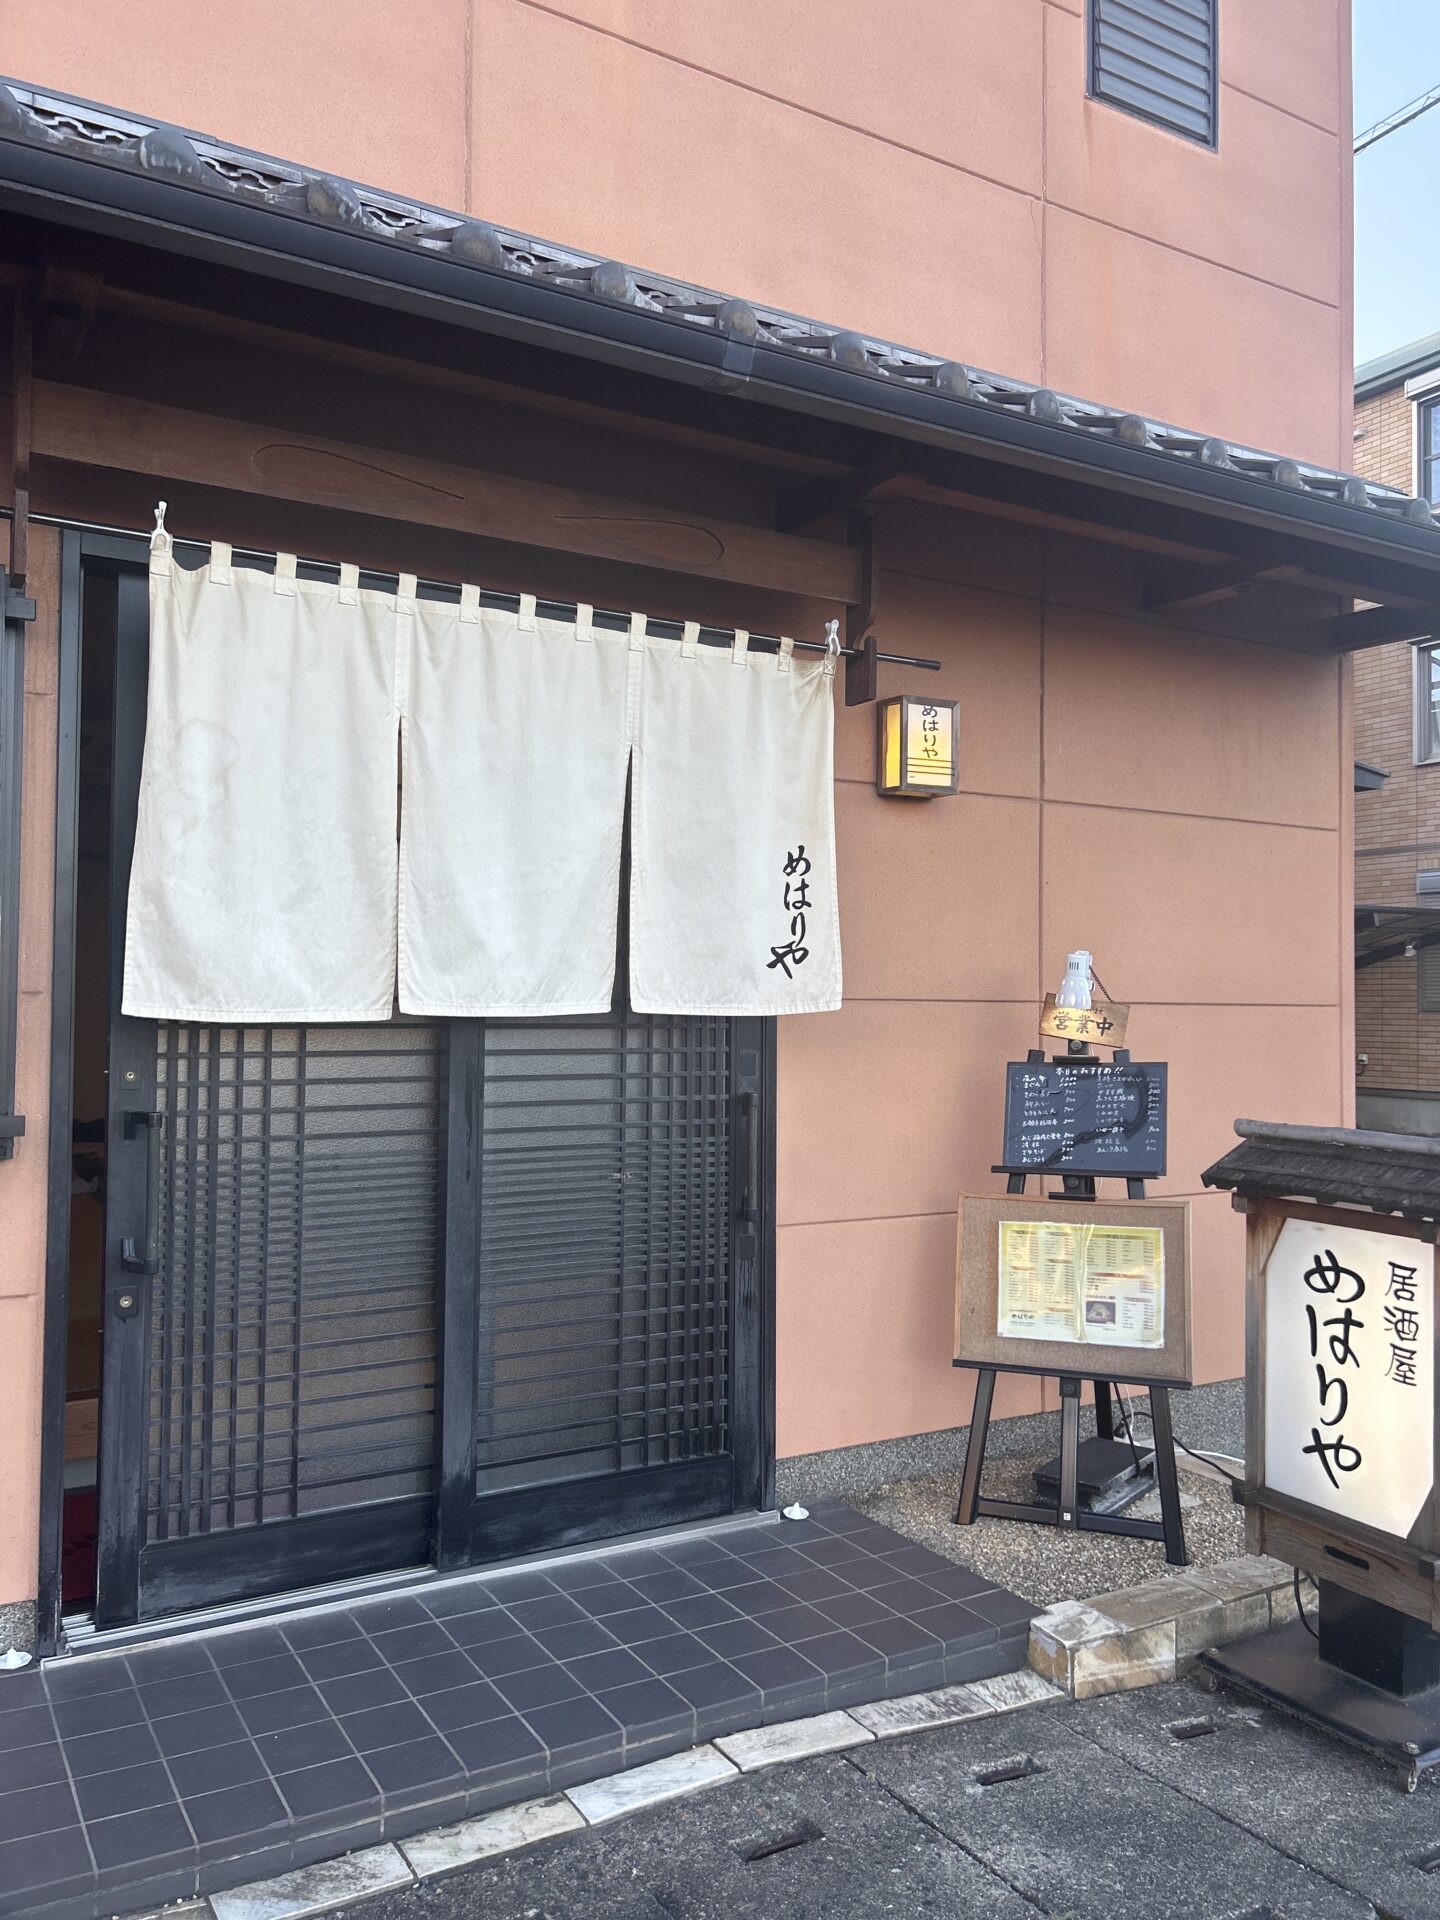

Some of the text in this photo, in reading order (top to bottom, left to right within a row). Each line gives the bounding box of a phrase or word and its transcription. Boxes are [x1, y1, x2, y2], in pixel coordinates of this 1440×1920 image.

[922, 705, 939, 758] めはりや
[766, 845, 812, 979] めはりや
[1053, 1011, 1114, 1036] 営業中
[1301, 1249, 1366, 1490] めはりや
[1384, 1261, 1420, 1387] 居酒屋
